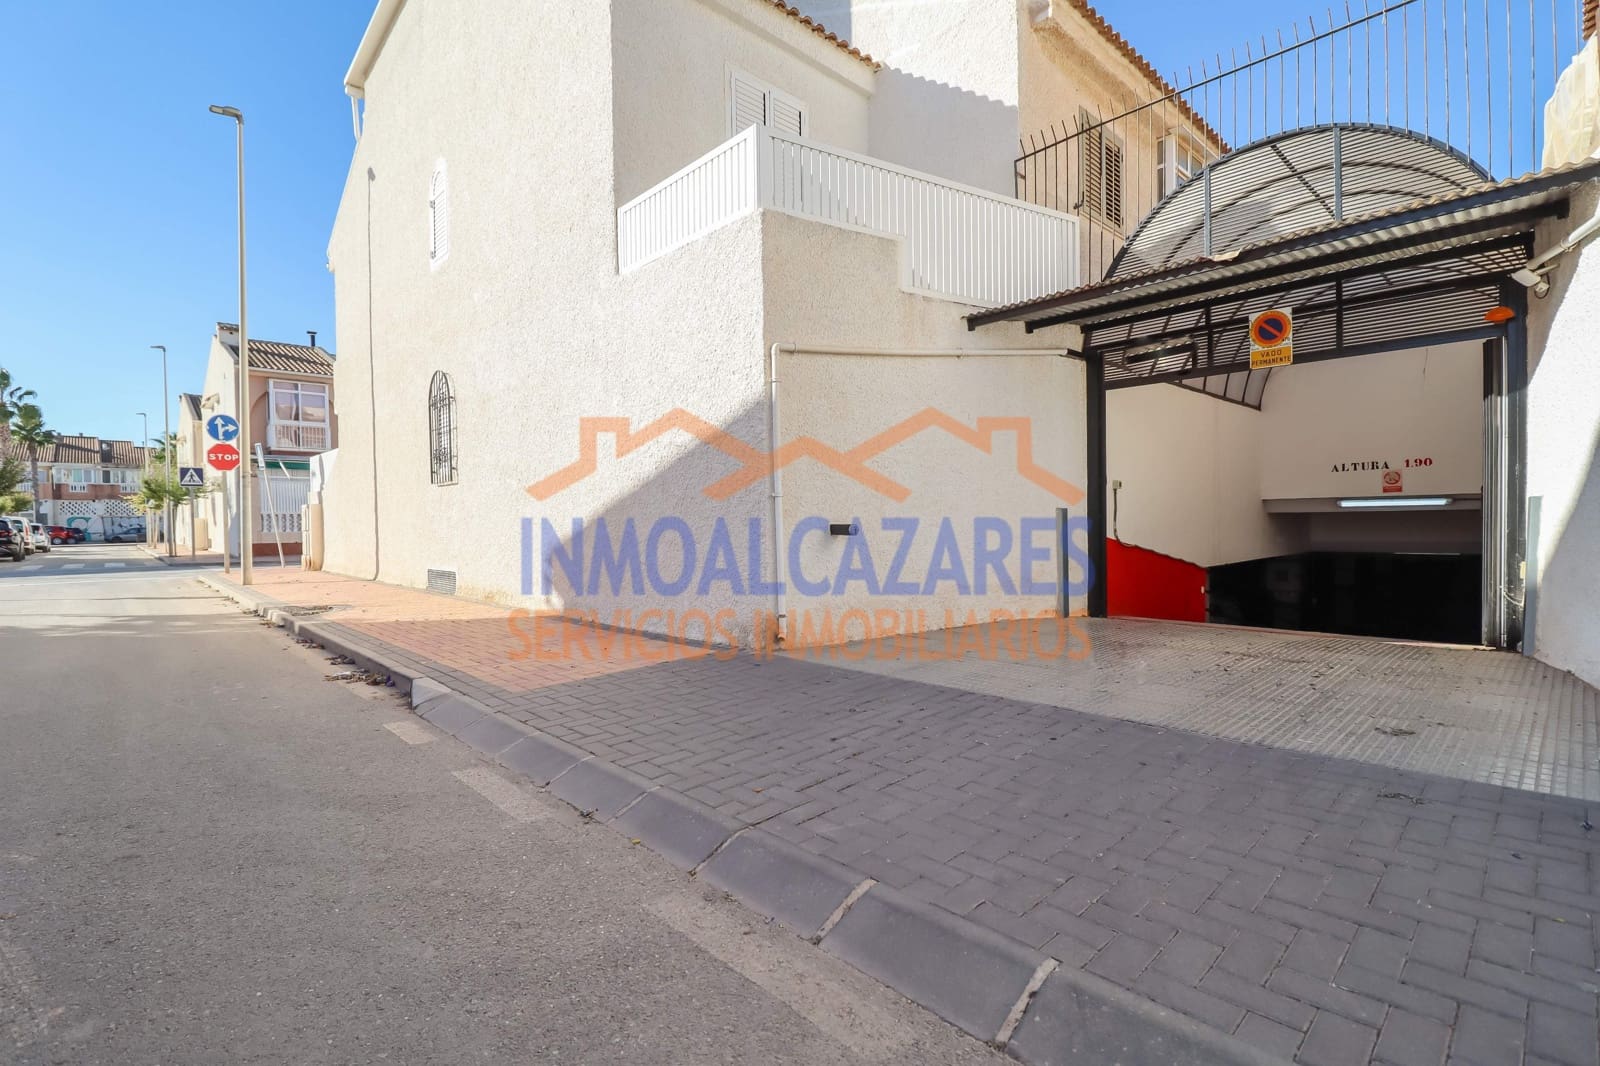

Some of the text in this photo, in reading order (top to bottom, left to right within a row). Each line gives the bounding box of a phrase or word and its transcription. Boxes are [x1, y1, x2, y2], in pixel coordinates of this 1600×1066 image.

[1260, 349, 1282, 358] VADO
[1251, 355, 1292, 366] PERMANENTE
[209, 453, 238, 461] STOP
[1331, 458, 1432, 472] ALTURA 1.90
